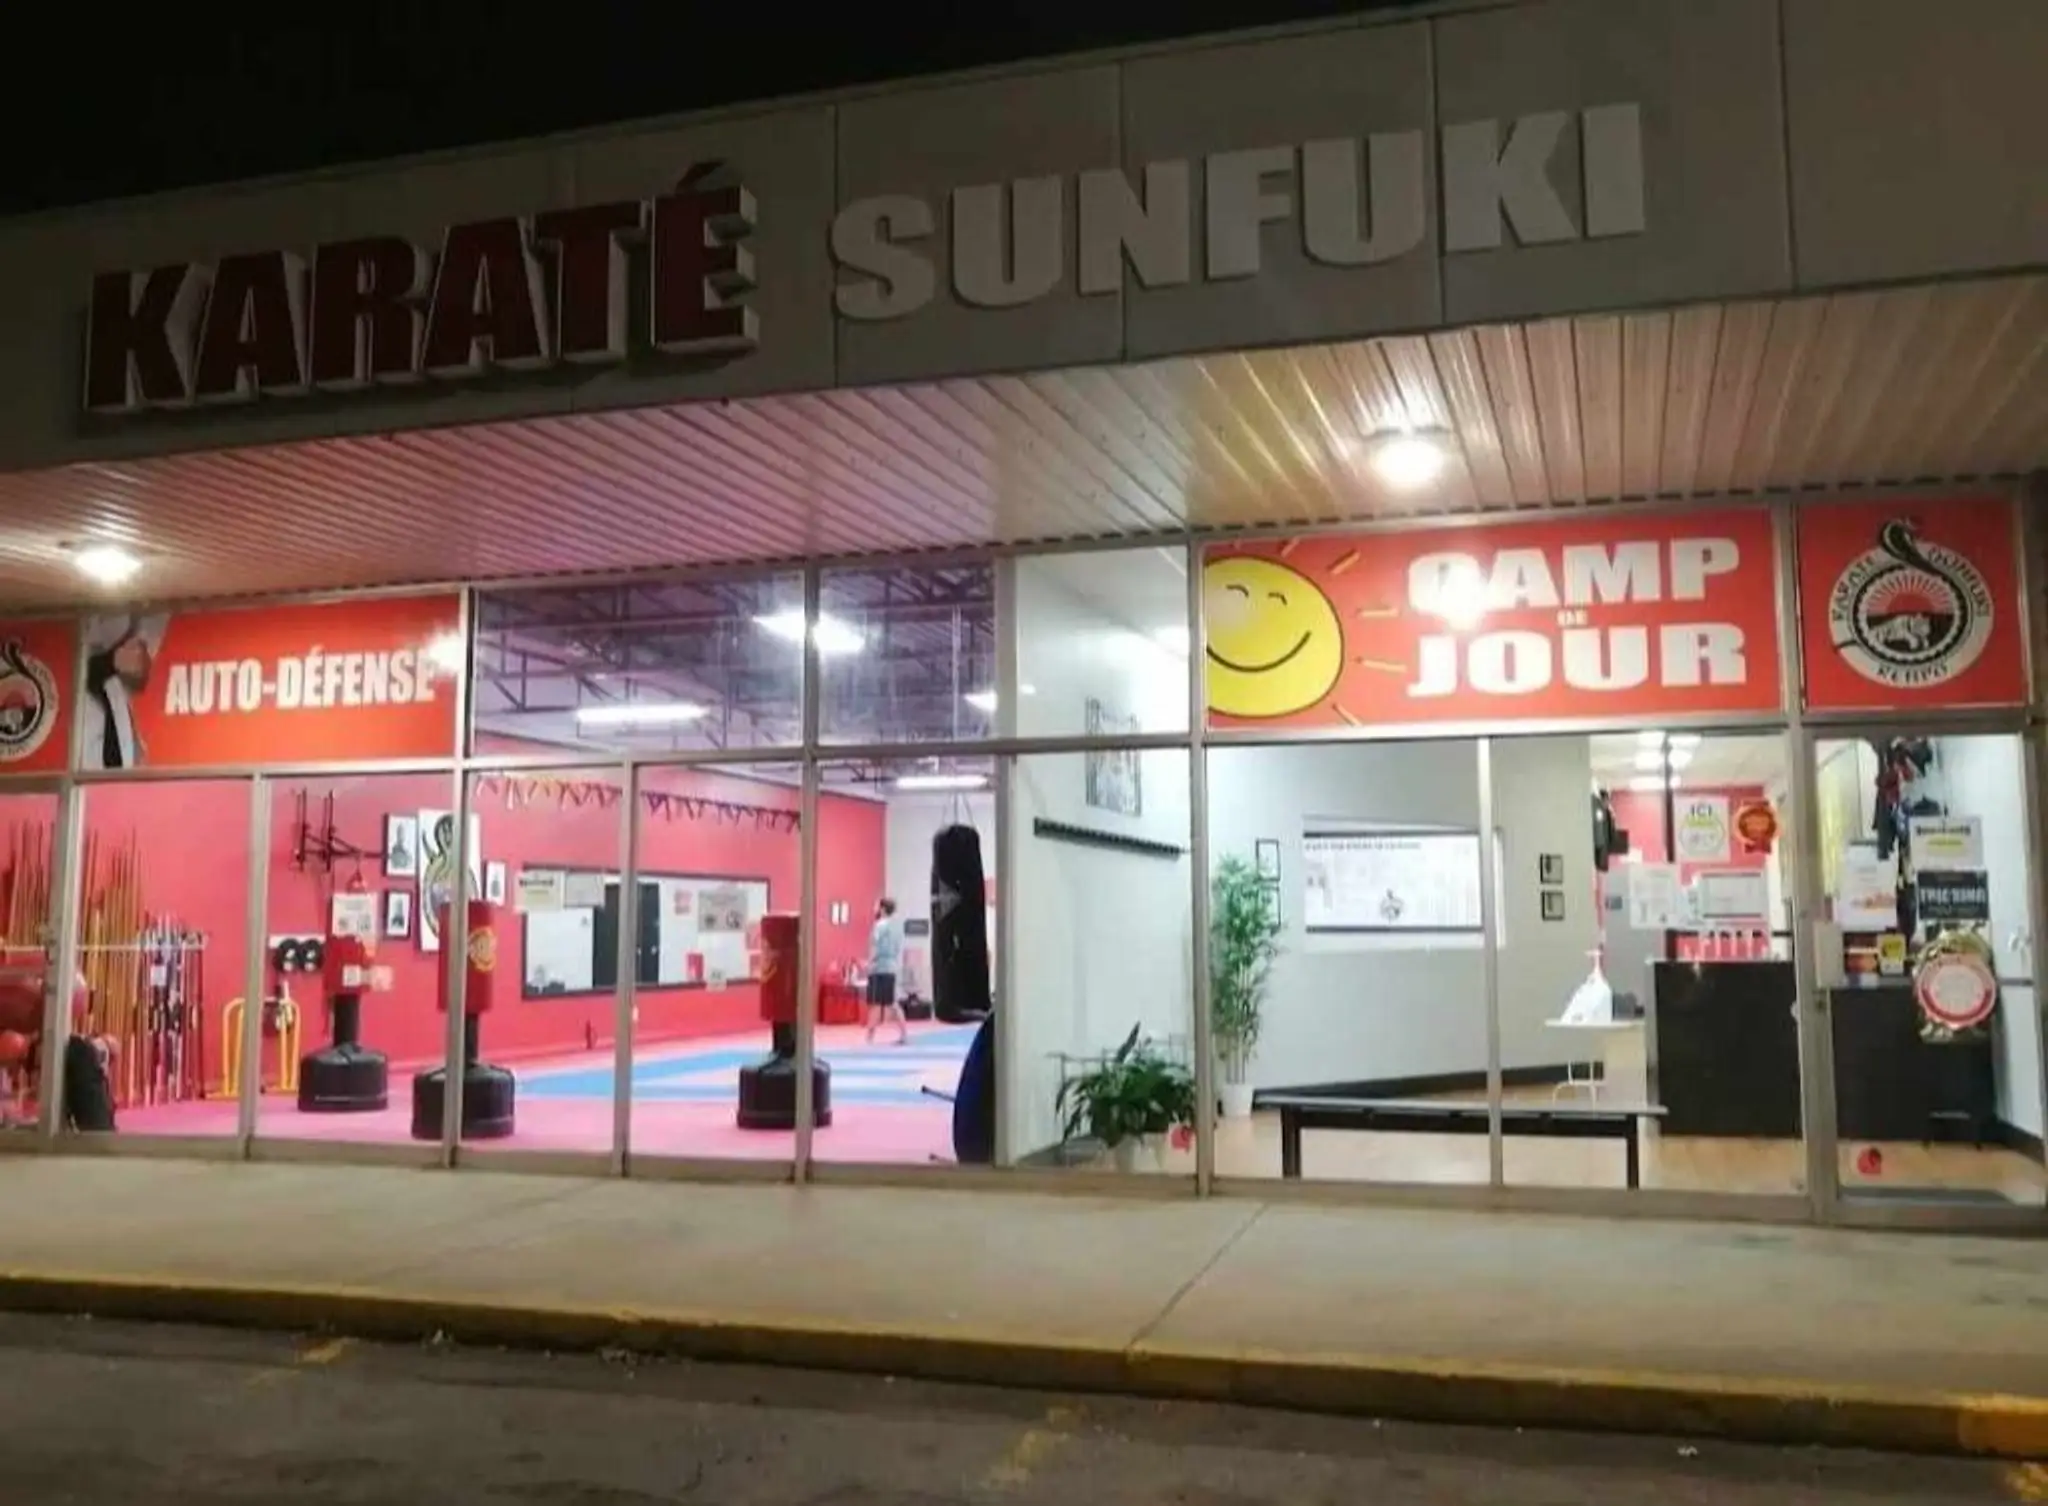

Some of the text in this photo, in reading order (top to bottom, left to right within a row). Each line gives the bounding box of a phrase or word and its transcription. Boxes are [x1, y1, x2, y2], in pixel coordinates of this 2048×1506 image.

[84, 102, 1645, 412] KARATÉ SUNFUKI
[164, 645, 437, 716] AUTO-DÉFENSE
[1407, 622, 1747, 697] JOUR
